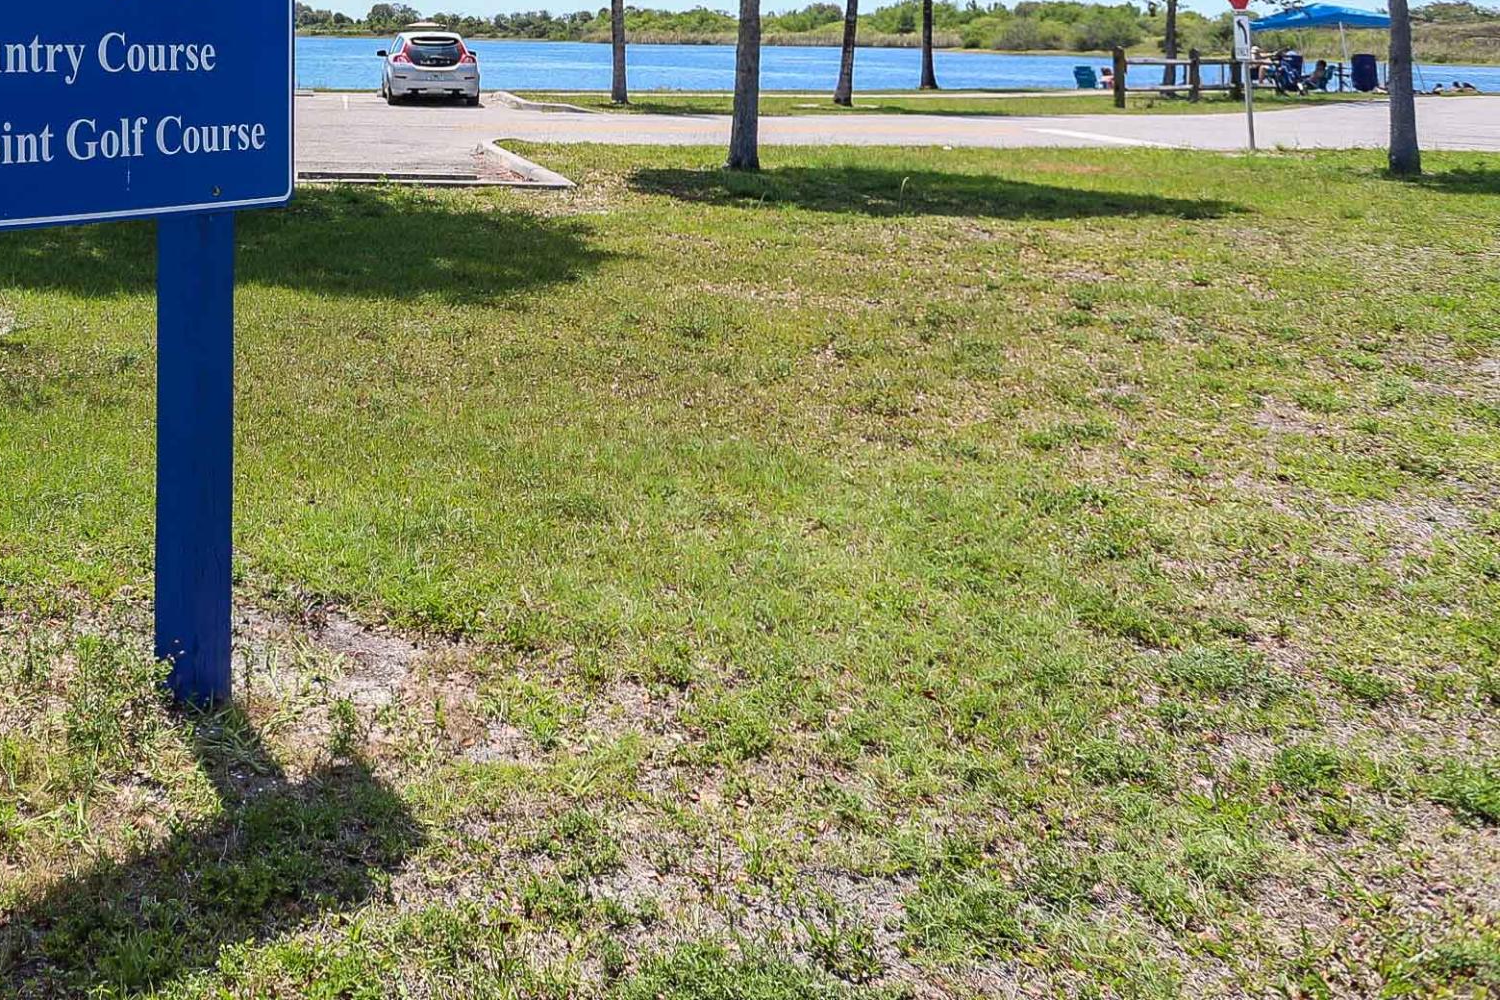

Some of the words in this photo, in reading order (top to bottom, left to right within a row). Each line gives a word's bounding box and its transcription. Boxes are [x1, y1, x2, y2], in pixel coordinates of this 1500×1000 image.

[97, 32, 217, 73] Course
[66, 116, 148, 158] Golf
[155, 115, 266, 155] Course
